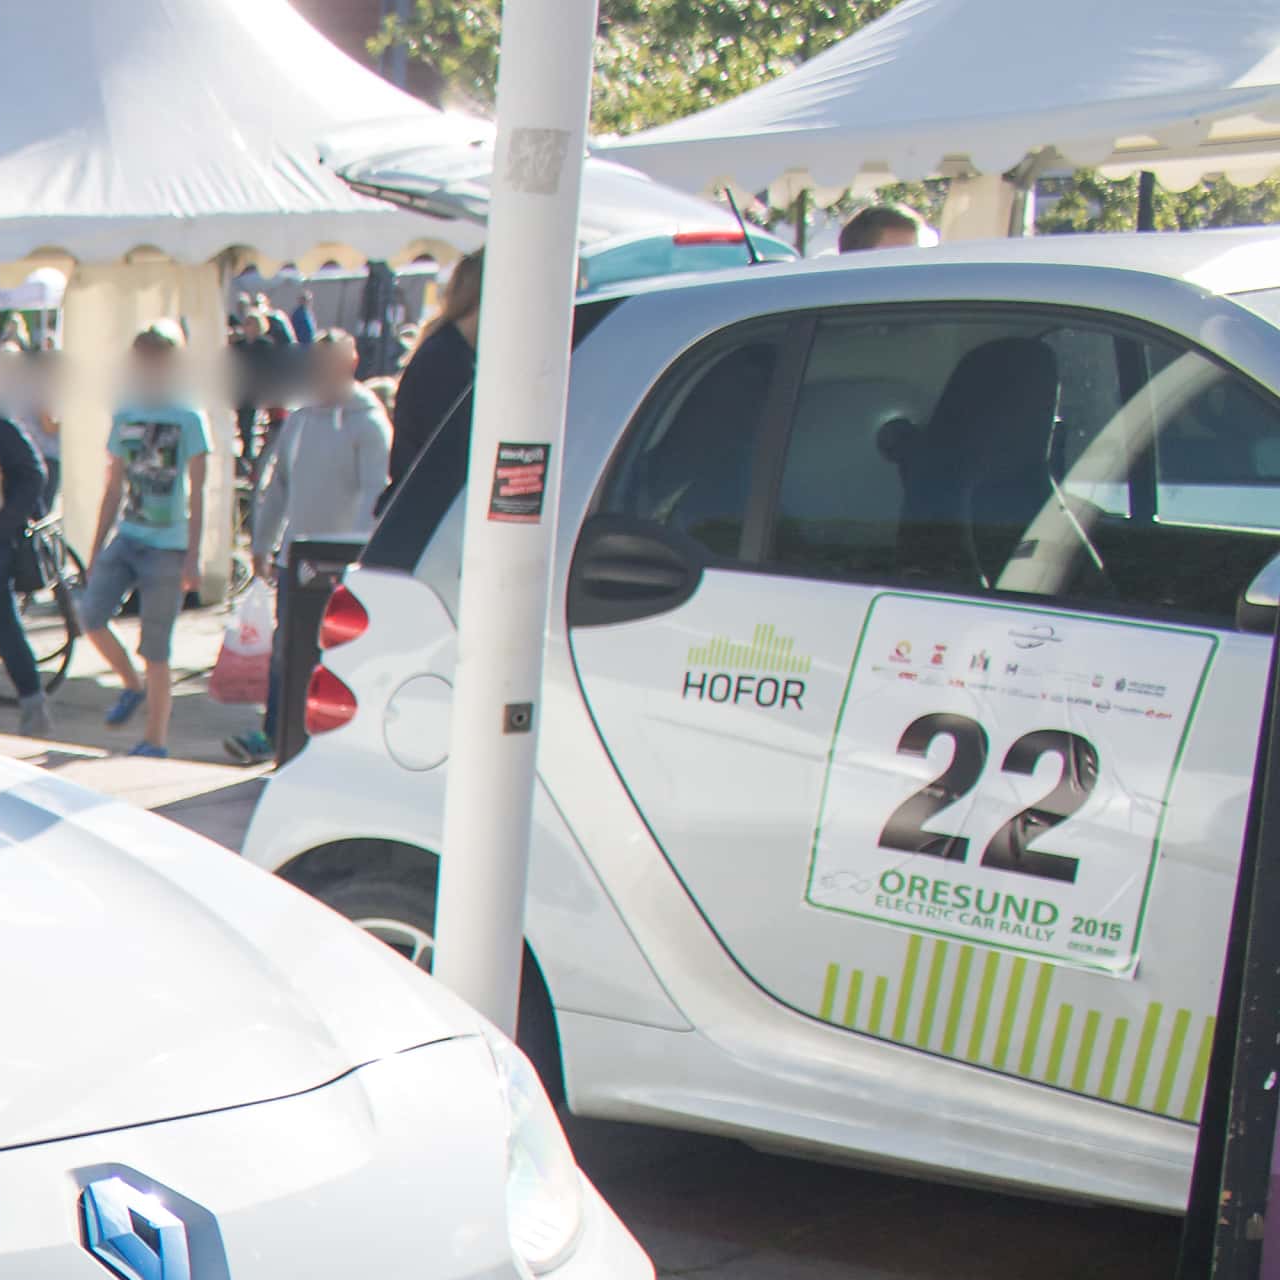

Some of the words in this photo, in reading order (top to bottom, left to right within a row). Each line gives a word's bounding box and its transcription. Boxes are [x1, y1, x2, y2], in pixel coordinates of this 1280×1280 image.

[682, 672, 806, 711] HOFOR
[877, 710, 1100, 884] 22
[874, 895, 954, 922] ELECTRIC
[959, 912, 995, 930] CAR
[999, 920, 1056, 943] RALLY
[1071, 916, 1124, 941] 2015
